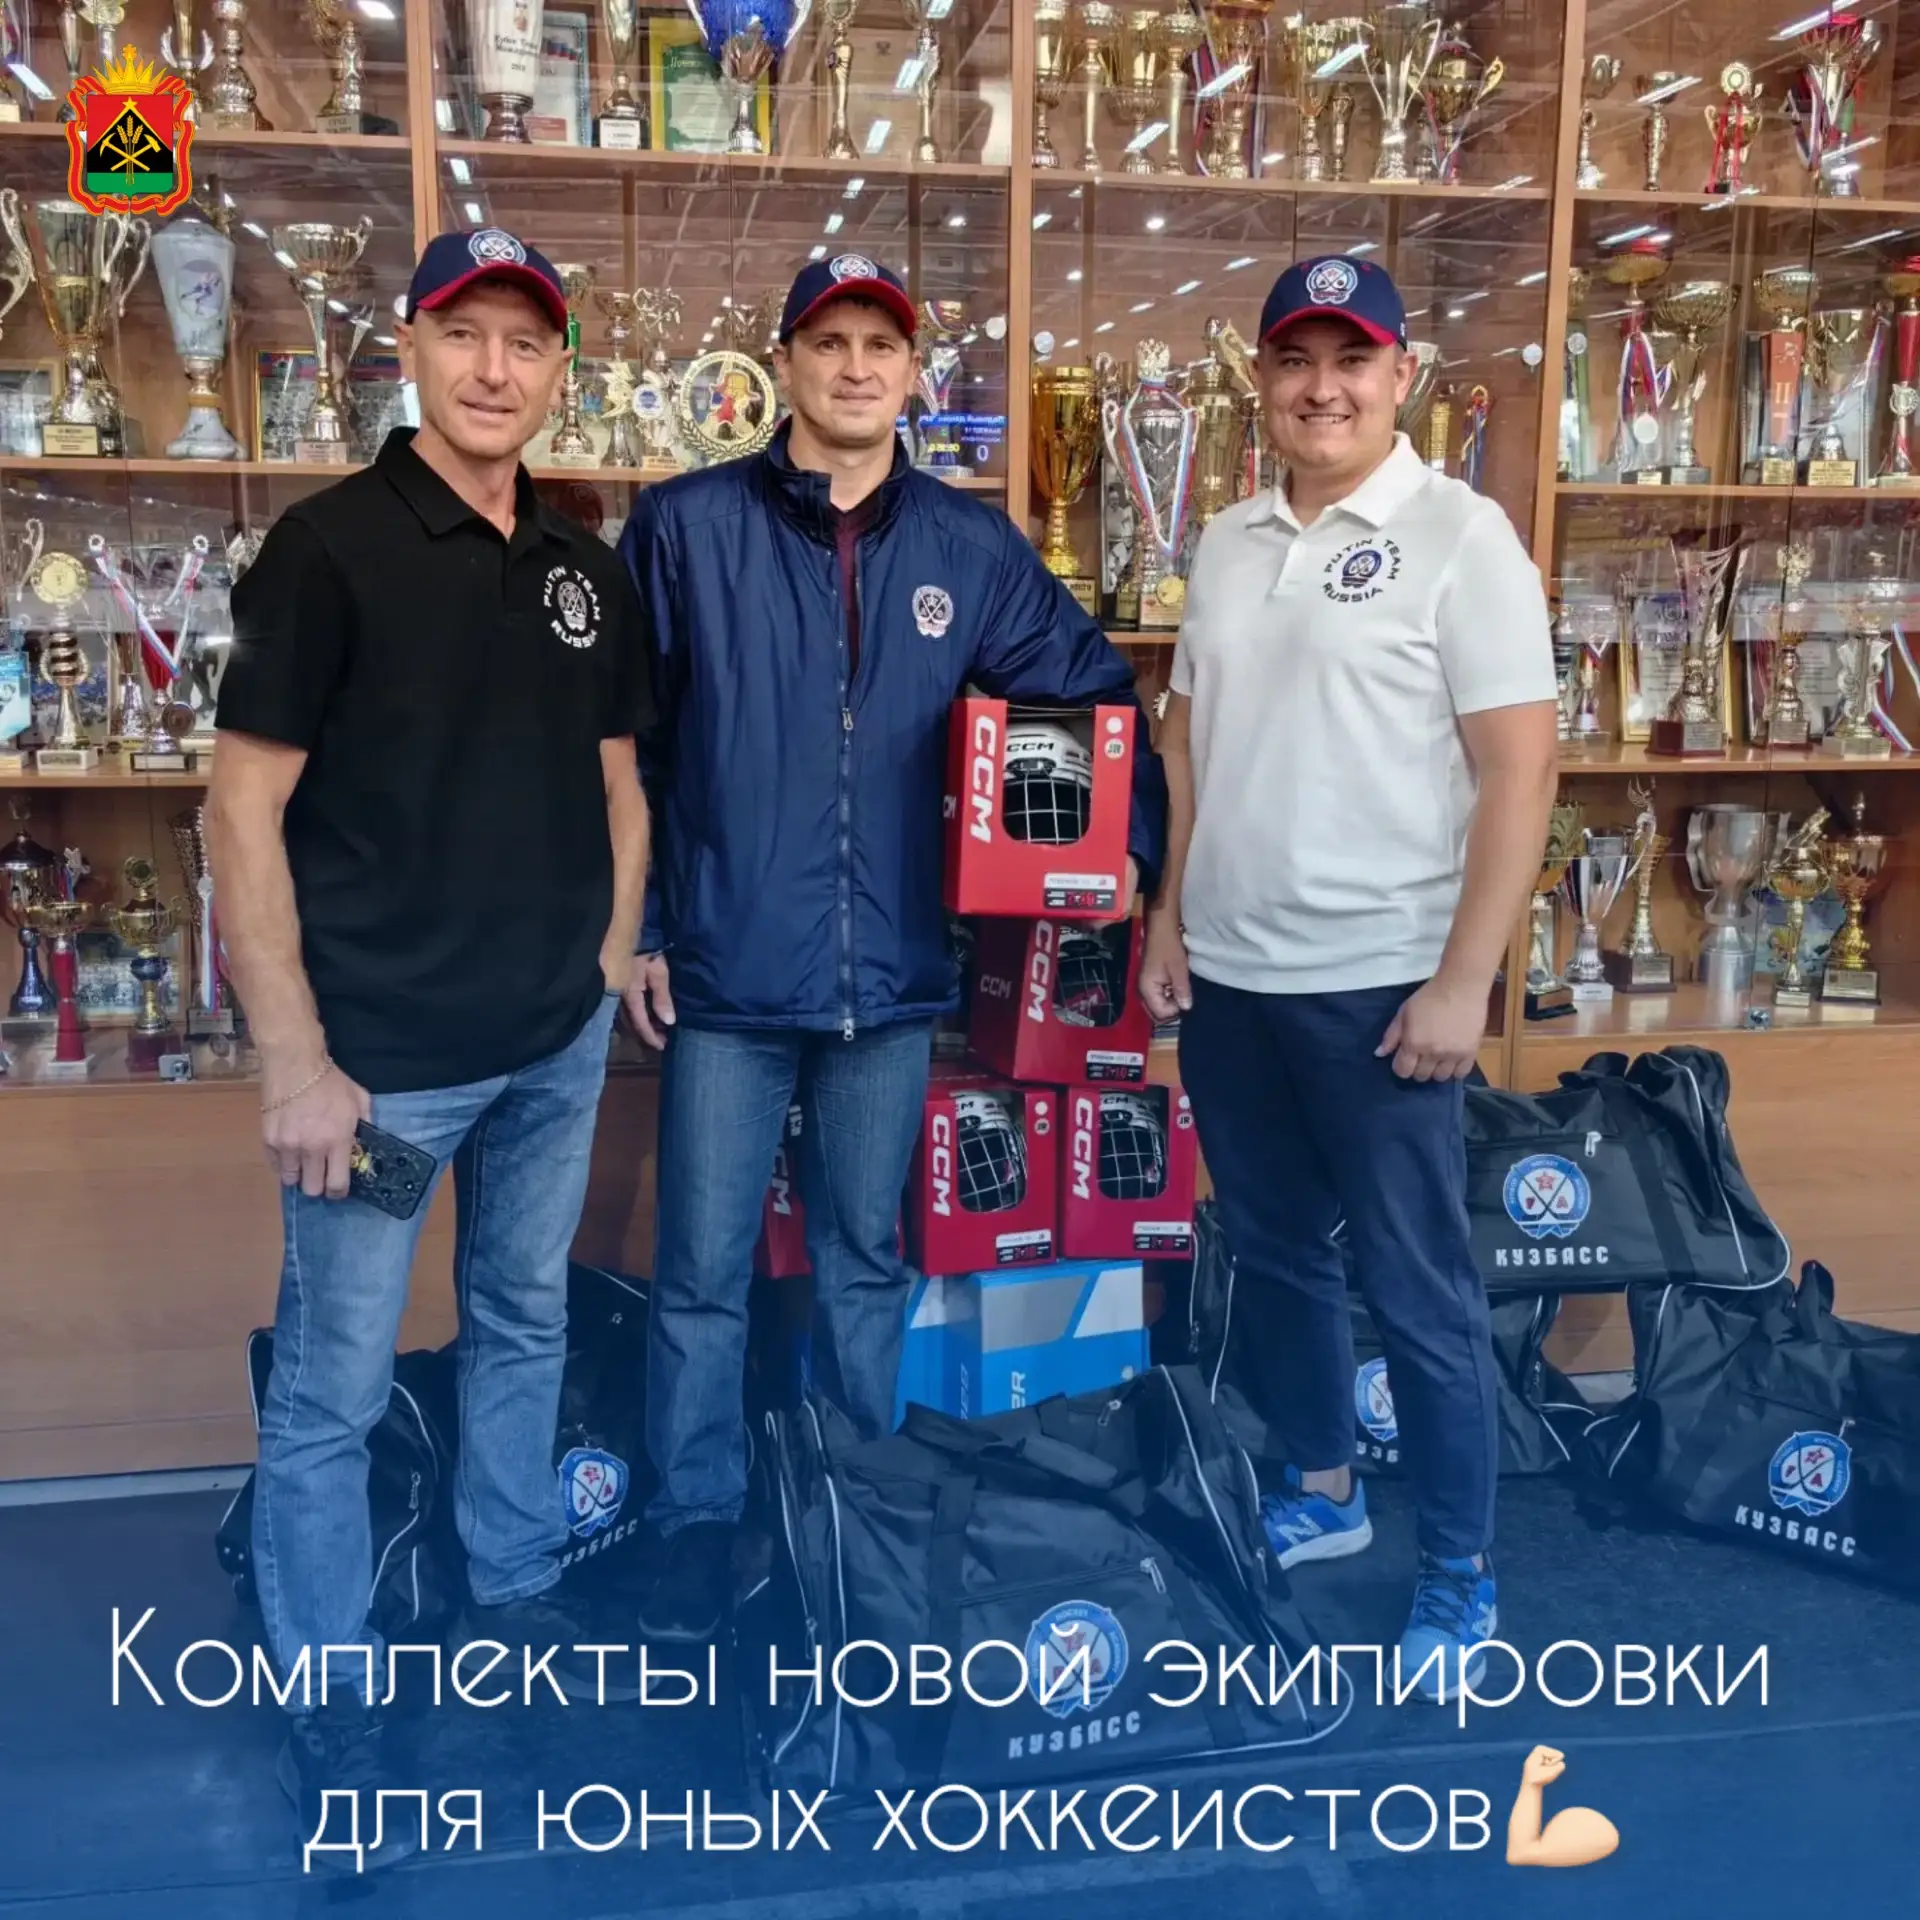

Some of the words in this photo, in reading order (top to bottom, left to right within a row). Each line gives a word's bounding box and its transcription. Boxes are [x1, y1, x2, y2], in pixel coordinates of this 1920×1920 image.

[1324, 538, 1373, 573] PUTIN
[1383, 539, 1402, 580] TEAM
[543, 565, 568, 607] PUTIN
[574, 569, 601, 620] TEAM
[1323, 581, 1384, 603] RUSSIA
[1006, 742, 1055, 752] CCM
[969, 714, 997, 844] CCM
[980, 973, 1012, 999] CCM
[1027, 918, 1053, 1023] CCM
[1103, 1095, 1130, 1105] CM
[1179, 1115, 1190, 1125] JR
[932, 1113, 951, 1217] CCM
[1072, 1097, 1094, 1200] CCM
[771, 1144, 792, 1216] CM
[1495, 1245, 1609, 1267] КУЗБАСС
[560, 1518, 638, 1568] УЗБАСС
[1735, 1504, 1856, 1557] КУЗБАСС
[1008, 1710, 1141, 1760] КУЗБАСС
